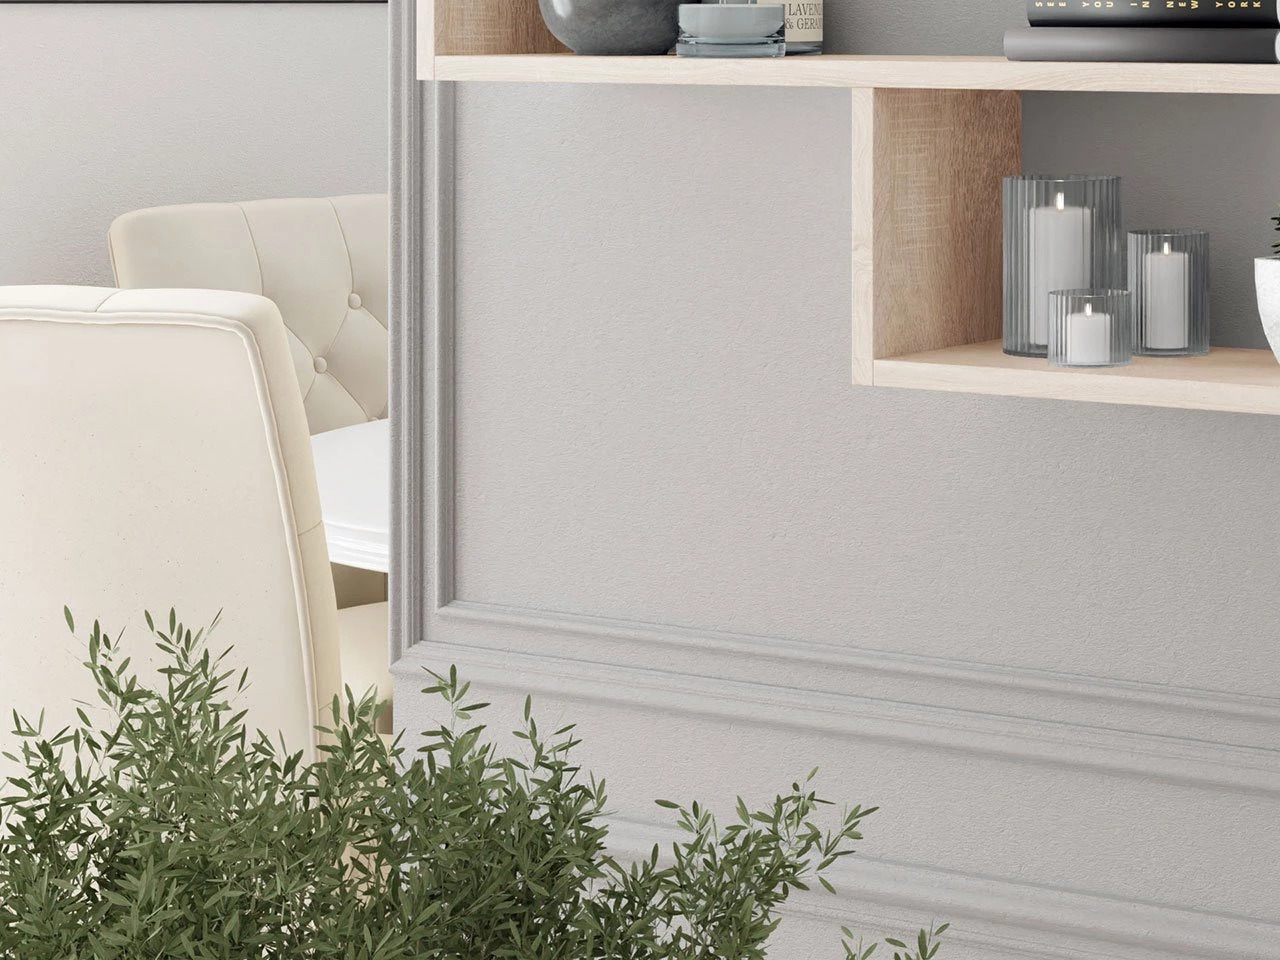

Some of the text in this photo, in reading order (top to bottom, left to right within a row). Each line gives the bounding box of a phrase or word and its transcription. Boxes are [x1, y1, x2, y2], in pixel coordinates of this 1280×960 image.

[789, 4, 823, 15] LAVEN
[1167, 0, 1199, 9] NEW
[785, 18, 823, 30] & GERA
